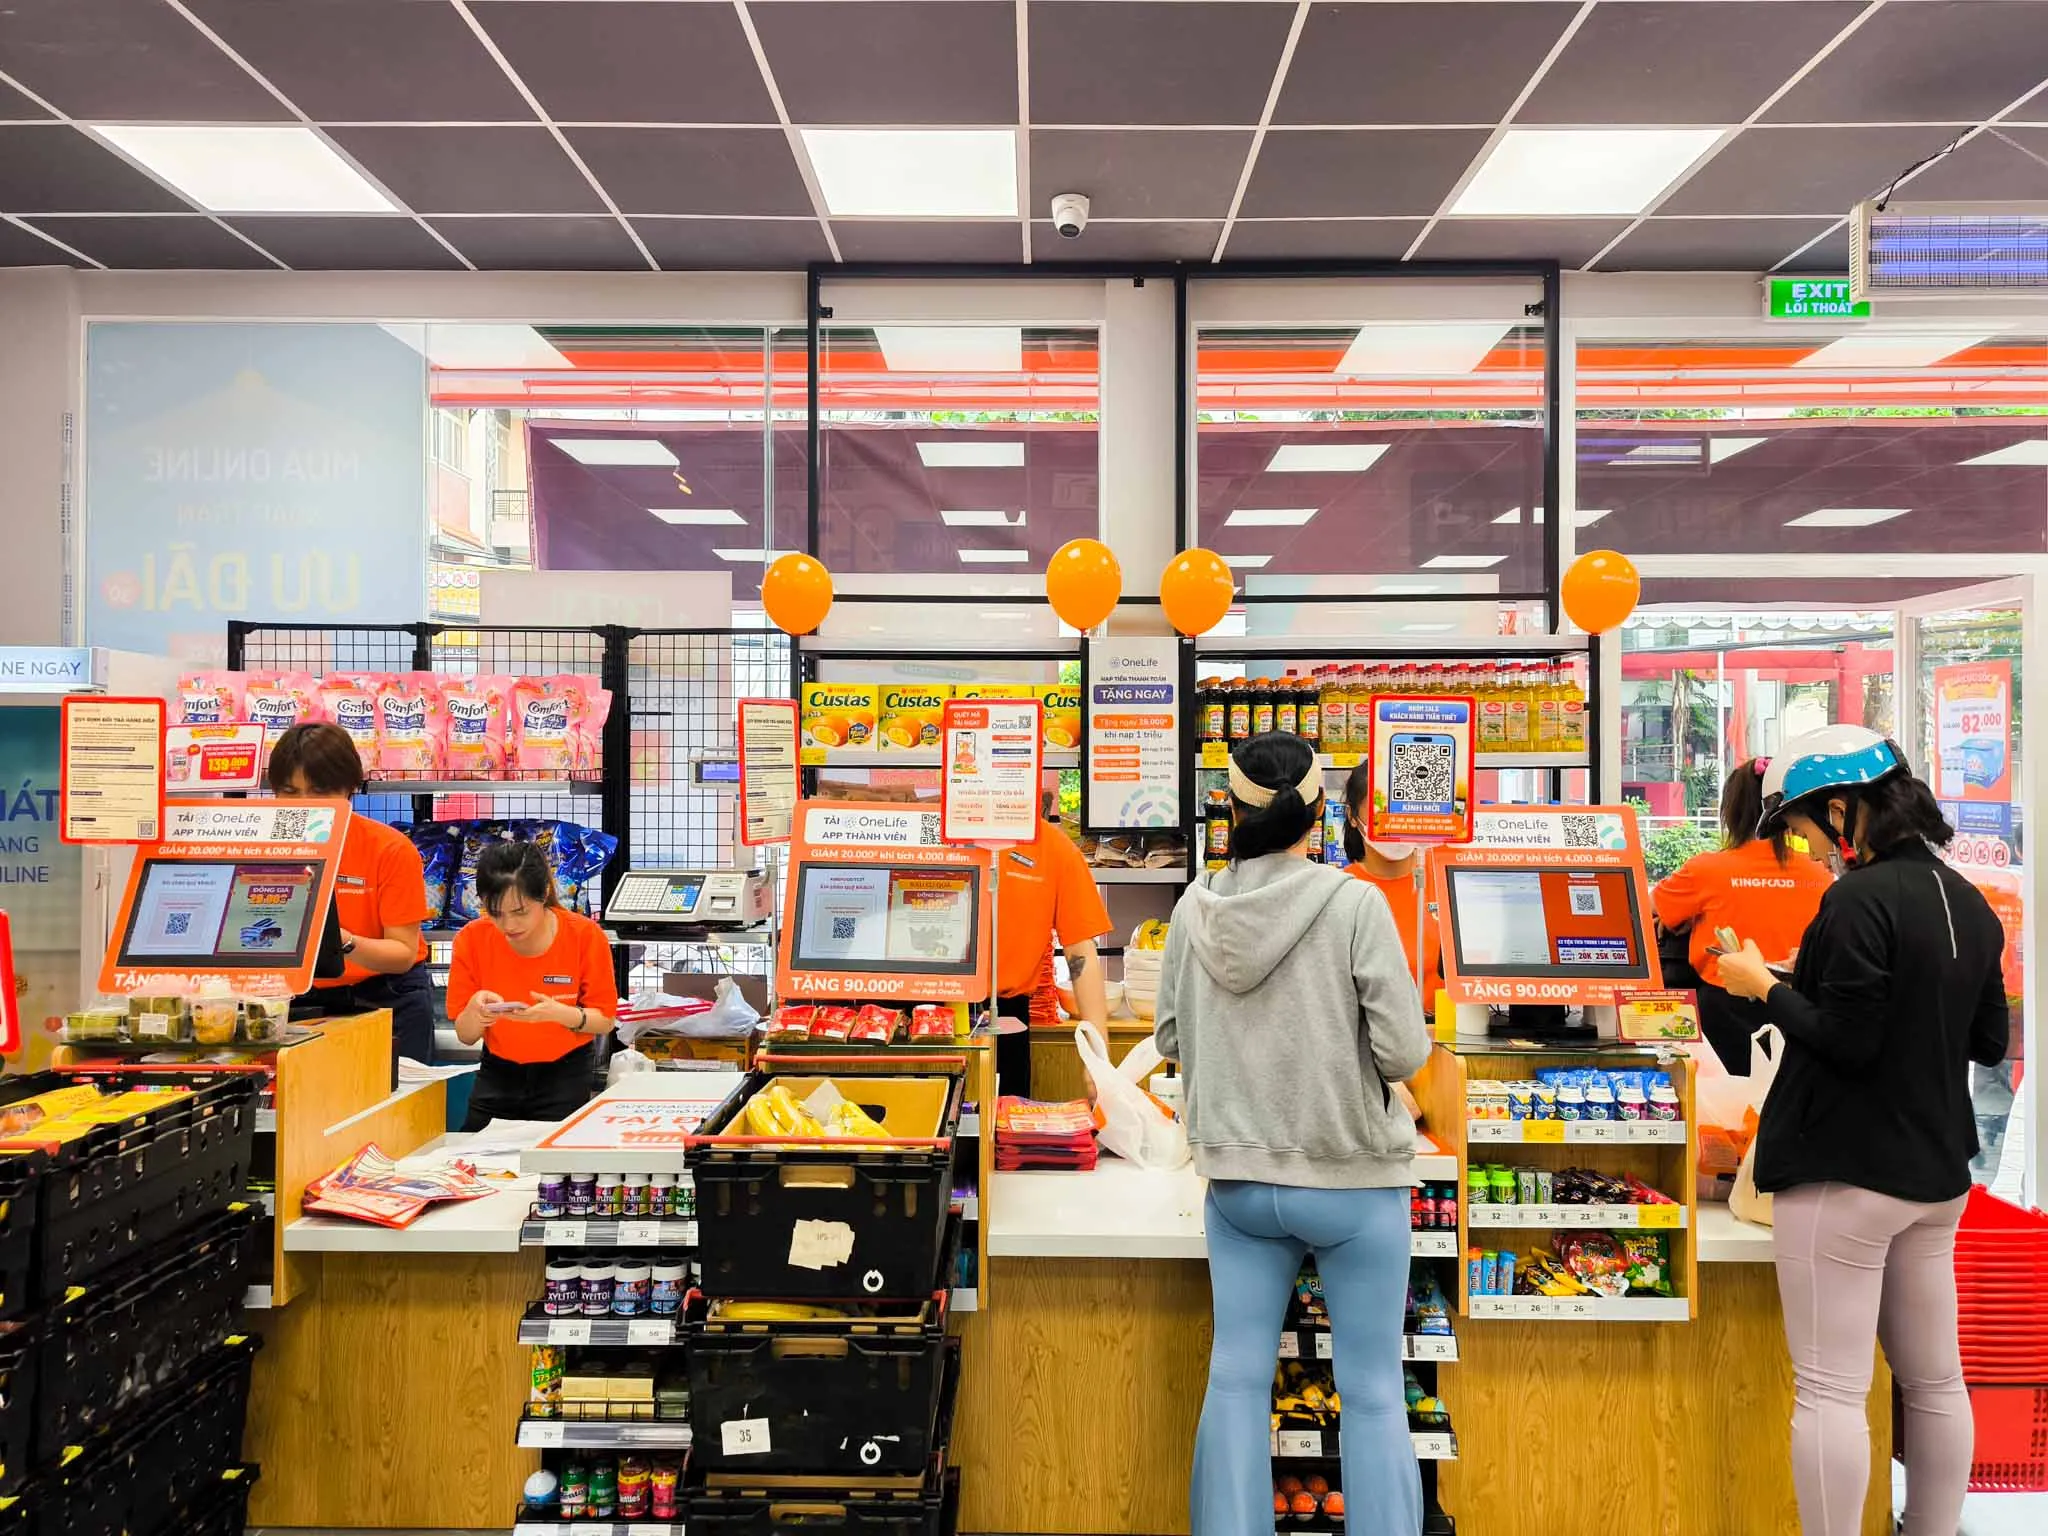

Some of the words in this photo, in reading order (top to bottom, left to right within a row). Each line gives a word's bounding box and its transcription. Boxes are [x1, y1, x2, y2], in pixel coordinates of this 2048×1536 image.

[1792, 283, 1849, 298] EXIT
[1812, 298, 1853, 313] THOÁT
[31, 661, 81, 675] NGAY
[1121, 657, 1159, 667] OneLife
[809, 691, 871, 707] Custas
[885, 692, 941, 708] Custas
[1043, 692, 1080, 708] Cus
[1101, 687, 1132, 702] TẶNG
[1135, 689, 1167, 699] NGAY
[184, 696, 220, 712] mfort
[256, 697, 297, 713] Comfort
[337, 698, 374, 714] Comfo
[384, 697, 426, 716] Comfort
[447, 699, 489, 717] Comfort
[528, 698, 570, 715] Comfort
[1390, 712, 1408, 720] KHÁCH
[1409, 712, 1424, 720] HÀNG
[1425, 712, 1440, 720] THÂN
[1105, 731, 1117, 739] khi
[0, 778, 60, 822] ÁT
[1402, 802, 1423, 812] KÍNH
[177, 813, 194, 823] TẢI
[212, 812, 262, 824] OneLife
[824, 816, 840, 825] TẢI
[858, 816, 908, 828] OneLife
[1497, 819, 1549, 830] OneLife
[172, 829, 194, 838] APP
[196, 827, 232, 838] THÀNH
[234, 827, 259, 838] VIÊN
[822, 831, 843, 841] APP
[846, 830, 881, 841] THÀNH
[884, 831, 907, 842] VIÊN
[1487, 834, 1523, 844] THÀNH
[1526, 834, 1551, 844] VIÊN
[226, 847, 241, 856] khi
[243, 847, 262, 857] tích
[293, 847, 318, 857] điểm
[811, 848, 839, 859] GIẢM
[880, 851, 895, 861] khi
[896, 852, 915, 862] tích
[946, 852, 970, 863] điểm
[1456, 852, 1484, 864] GIẢM
[1525, 854, 1541, 863] khi
[1543, 854, 1562, 863] tích
[1595, 854, 1620, 865] điểm
[0, 865, 49, 883] LINE
[113, 970, 152, 992] TẶN
[791, 973, 840, 995] TẶNG
[1461, 979, 1511, 1001] TẶNG
[1654, 1002, 1674, 1012] 25K
[1491, 1128, 1502, 1136] 36
[1594, 1129, 1605, 1137] 32
[1647, 1129, 1658, 1137] 30
[564, 1230, 575, 1238] 32
[639, 1230, 648, 1239] 32
[1437, 1241, 1447, 1249] 35
[548, 1290, 578, 1301] XYLITOL
[581, 1290, 611, 1301] XYLITOL
[1493, 1304, 1504, 1312] 34
[1530, 1304, 1541, 1312] 26
[1573, 1304, 1584, 1312] 26
[1435, 1345, 1446, 1353] 25
[739, 1429, 752, 1443] 35
